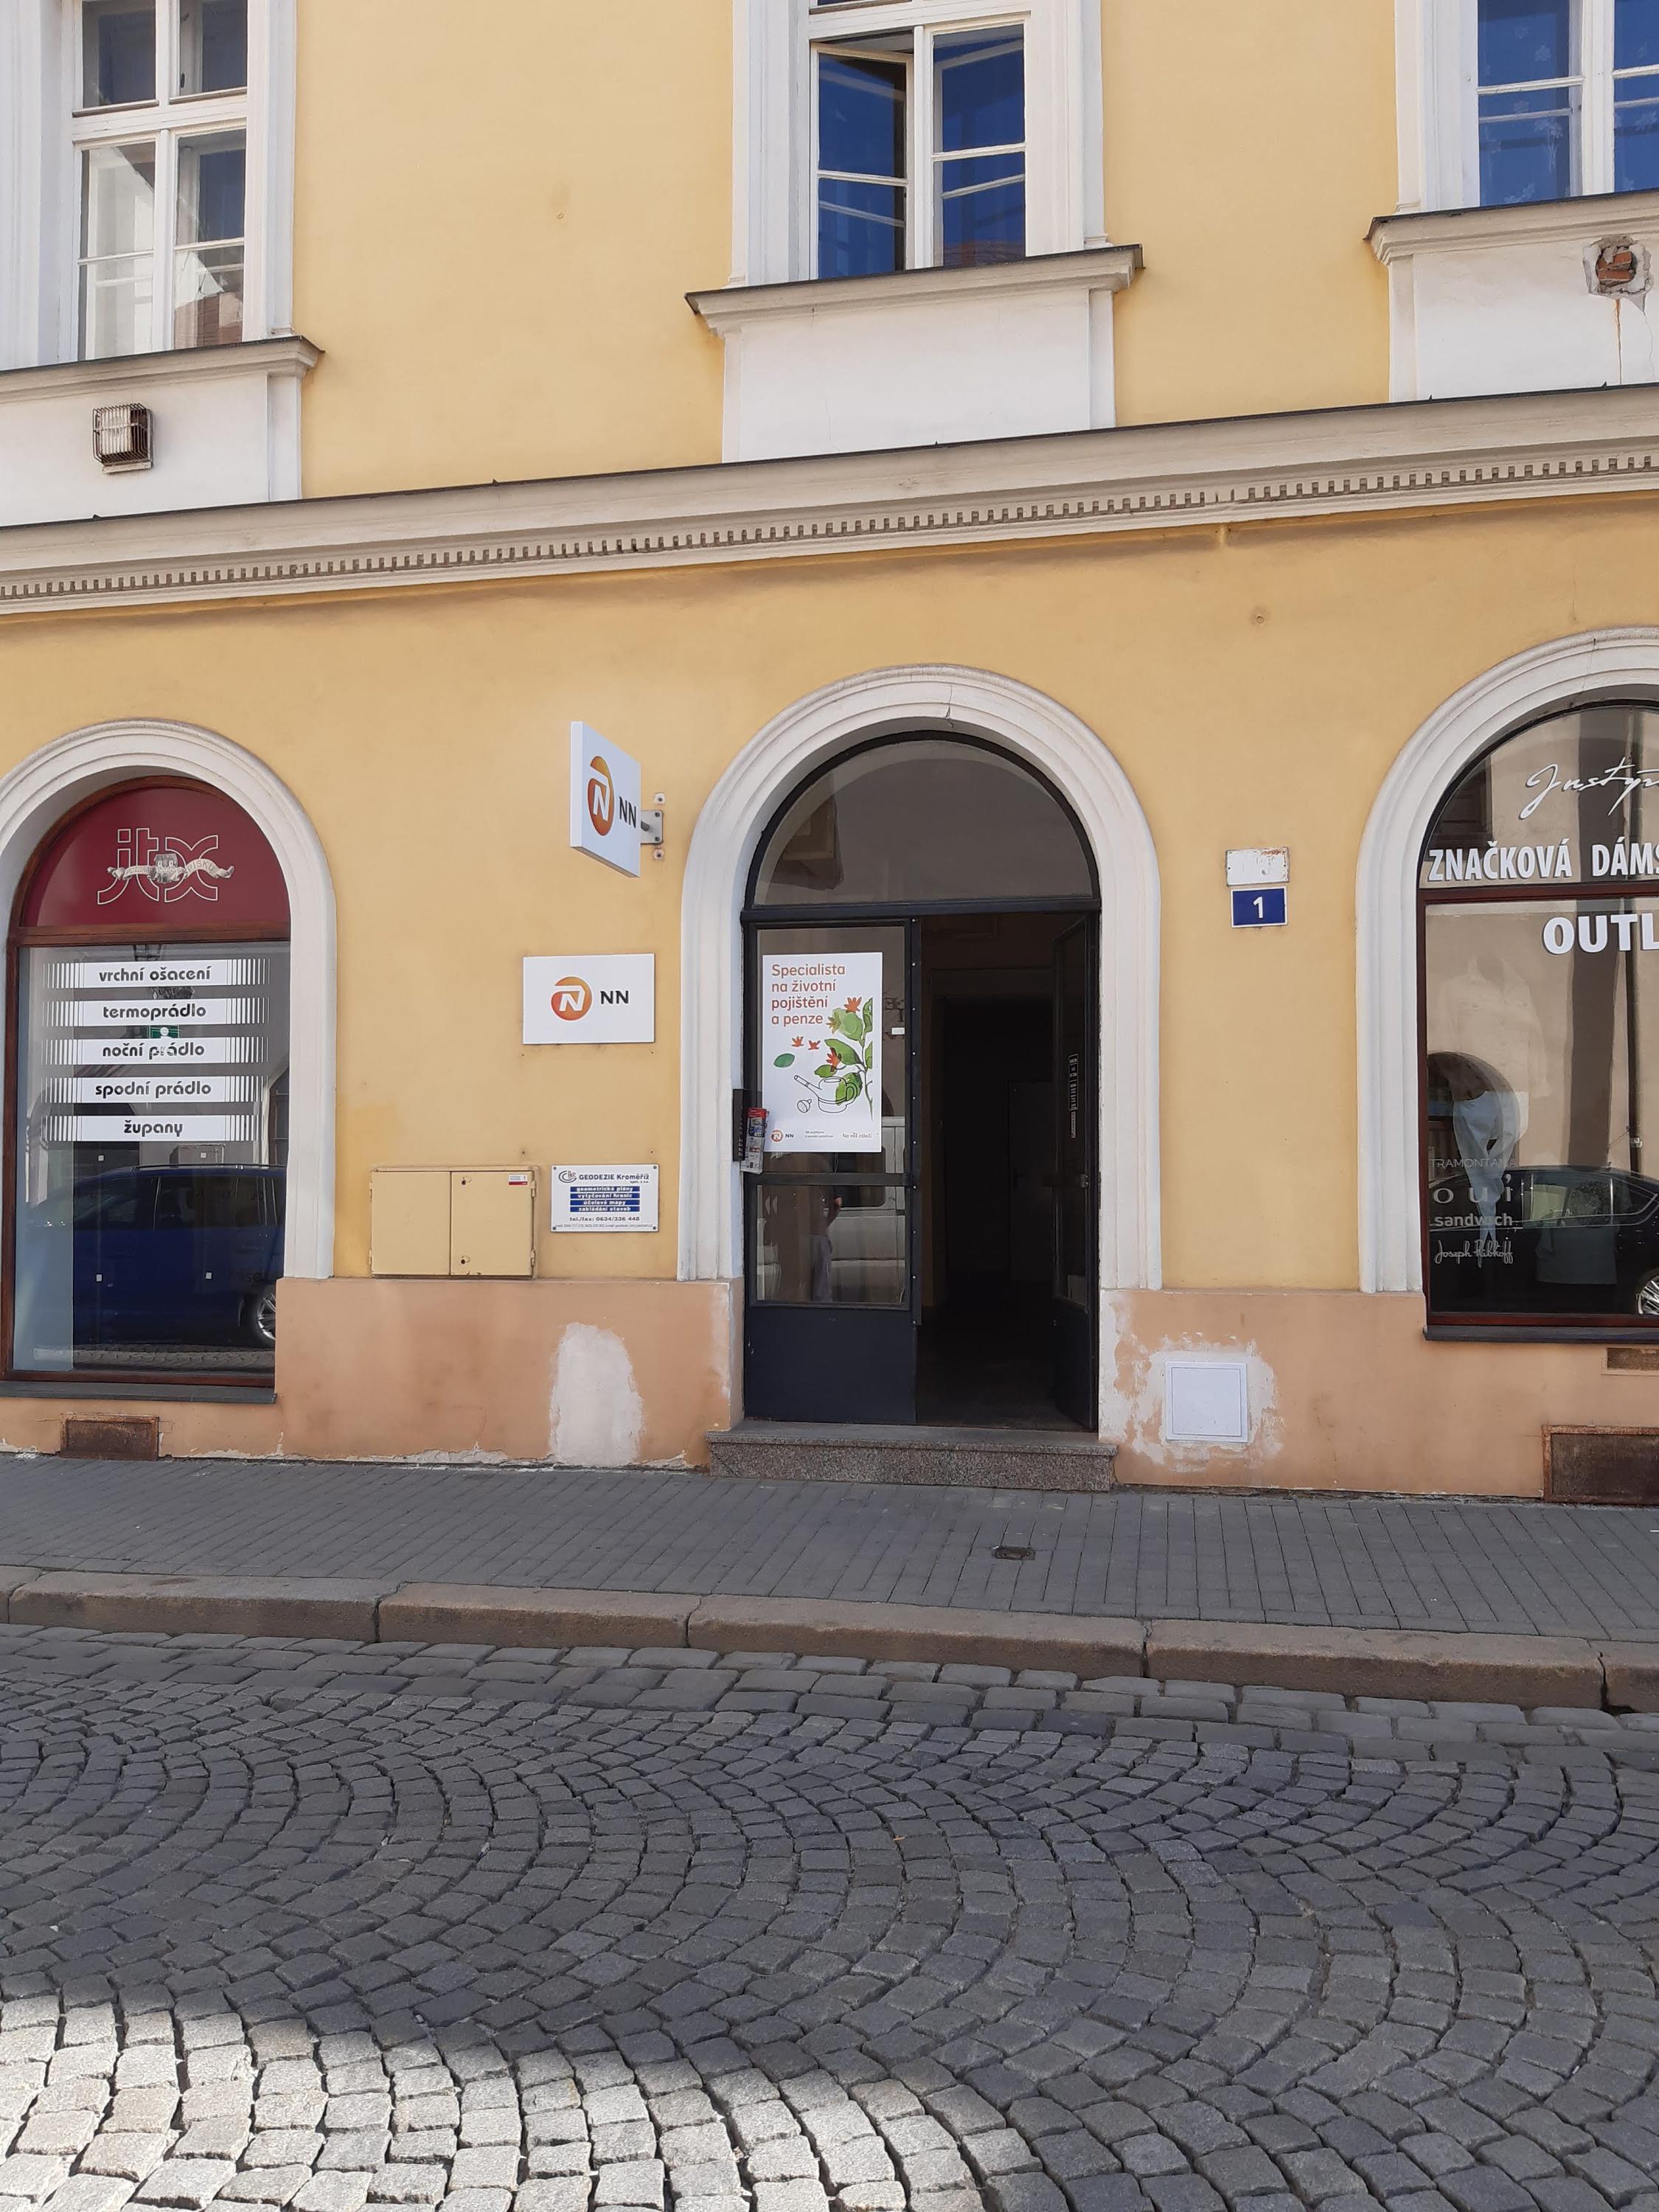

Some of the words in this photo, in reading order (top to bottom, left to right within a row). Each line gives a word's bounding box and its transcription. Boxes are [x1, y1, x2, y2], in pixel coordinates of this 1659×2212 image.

[619, 796, 637, 830] NN
[1427, 838, 1573, 881] ZNAČKOVÁ
[1253, 896, 1263, 919] 1
[1543, 913, 1659, 954] OUTL
[98, 967, 145, 982] vrchní
[150, 965, 211, 981] ošacení
[771, 963, 846, 978] Specialista
[771, 981, 788, 992] na
[792, 979, 837, 992] životní
[599, 990, 629, 1005] NN
[771, 995, 829, 1012] pojištění
[102, 1004, 207, 1020] termoprádlo
[771, 1015, 779, 1025] a
[784, 1015, 824, 1027] penze
[102, 1043, 145, 1057] noční
[149, 1042, 205, 1060] prádlo
[95, 1082, 149, 1099] spodní
[155, 1080, 212, 1097] prádlo
[123, 1119, 184, 1138] župany
[1435, 1213, 1513, 1227] sandwch
[1435, 1239, 1472, 1265] Joseph
